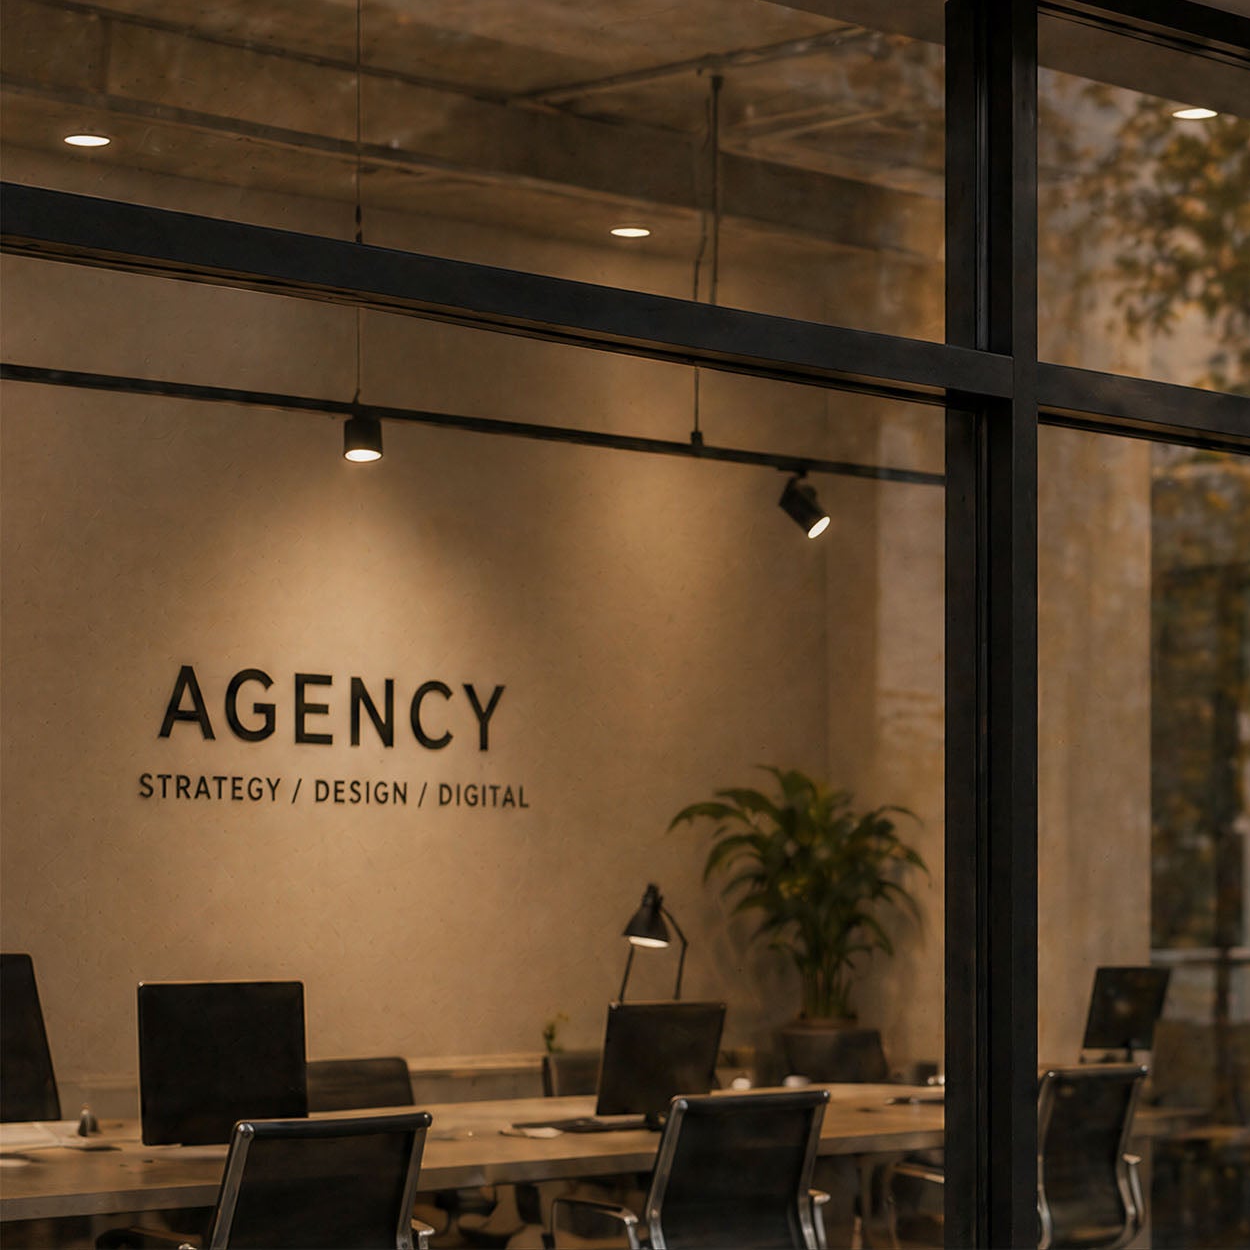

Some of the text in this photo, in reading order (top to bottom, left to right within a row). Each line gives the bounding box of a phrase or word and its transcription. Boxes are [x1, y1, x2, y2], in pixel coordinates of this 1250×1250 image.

[157, 665, 506, 751] AGENCY
[138, 773, 281, 802] STRATEGY
[314, 779, 407, 804] DESIGN
[438, 784, 530, 809] DIGITAL
